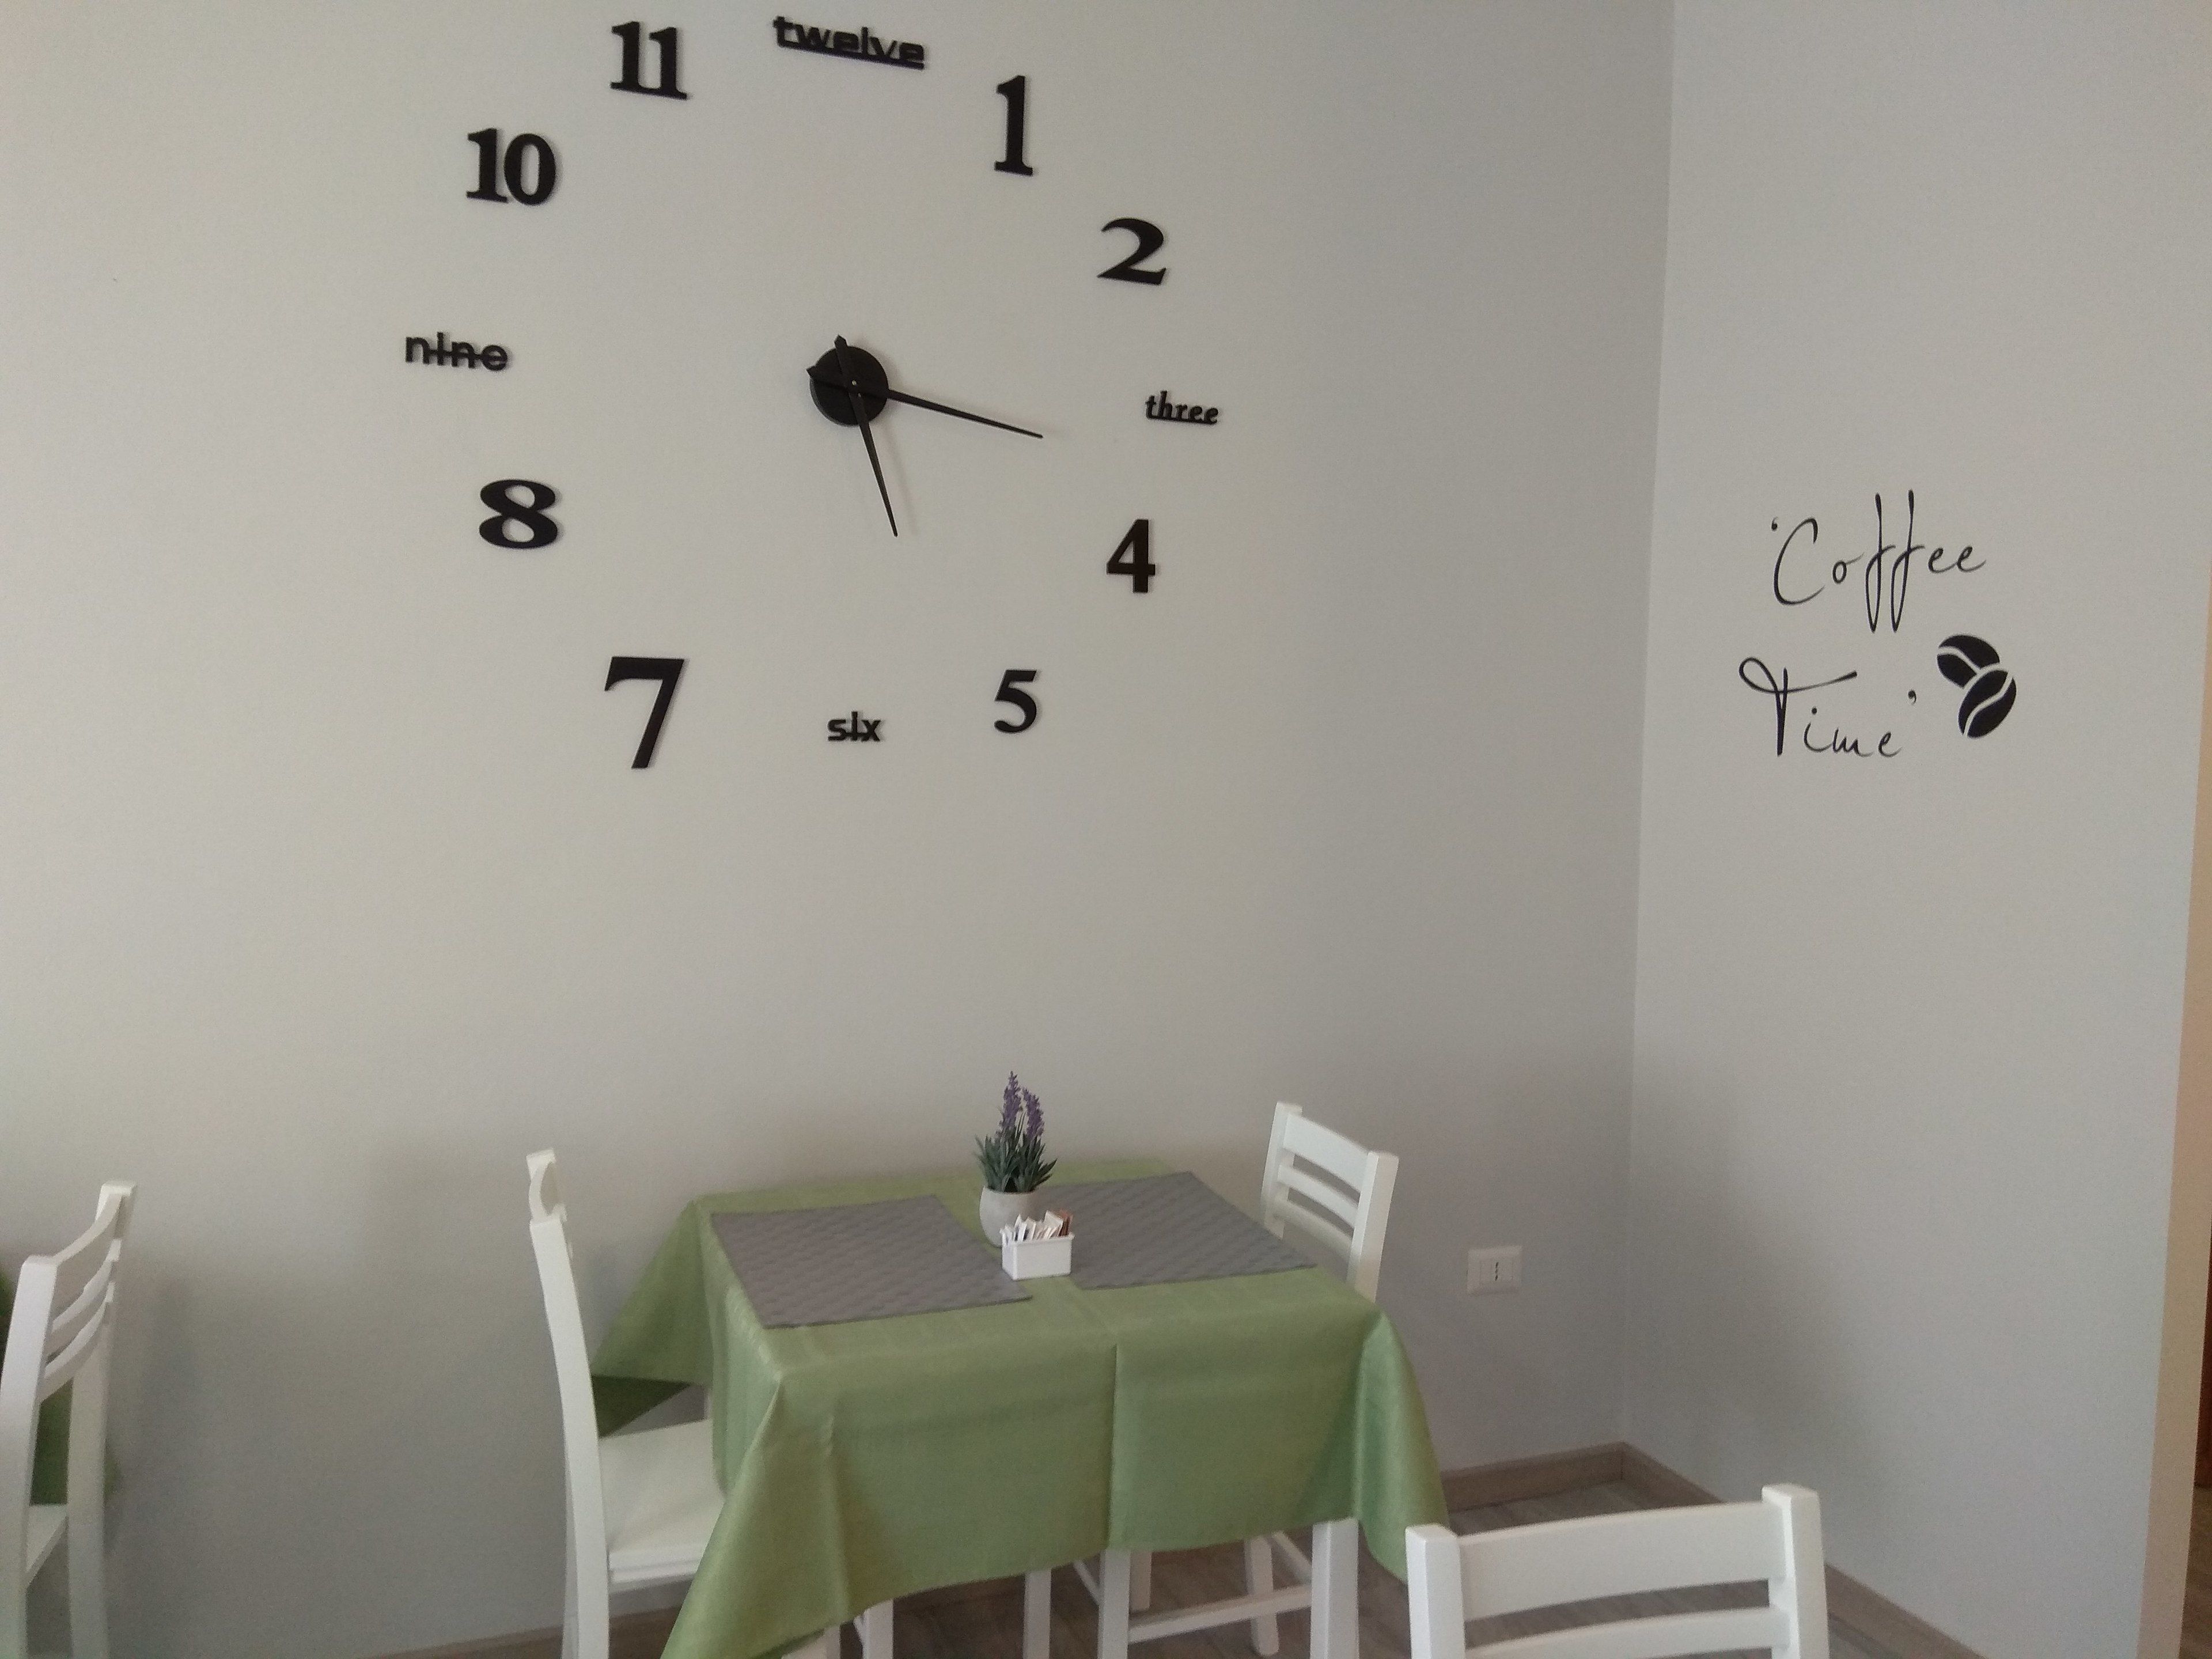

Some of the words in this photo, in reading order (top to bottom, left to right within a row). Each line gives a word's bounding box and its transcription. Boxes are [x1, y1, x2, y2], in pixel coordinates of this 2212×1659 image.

[610, 21, 688, 101] 11
[772, 16, 926, 71] twelve
[994, 74, 1033, 177] 1
[466, 128, 558, 207] 10
[1097, 217, 1168, 287] 2
[405, 331, 509, 372] nine
[1145, 389, 1219, 426] three
[479, 479, 559, 550] 8
[1106, 518, 1156, 594] 4
[604, 656, 685, 770] 7
[827, 710, 882, 743] six
[994, 669, 1040, 734] 5
